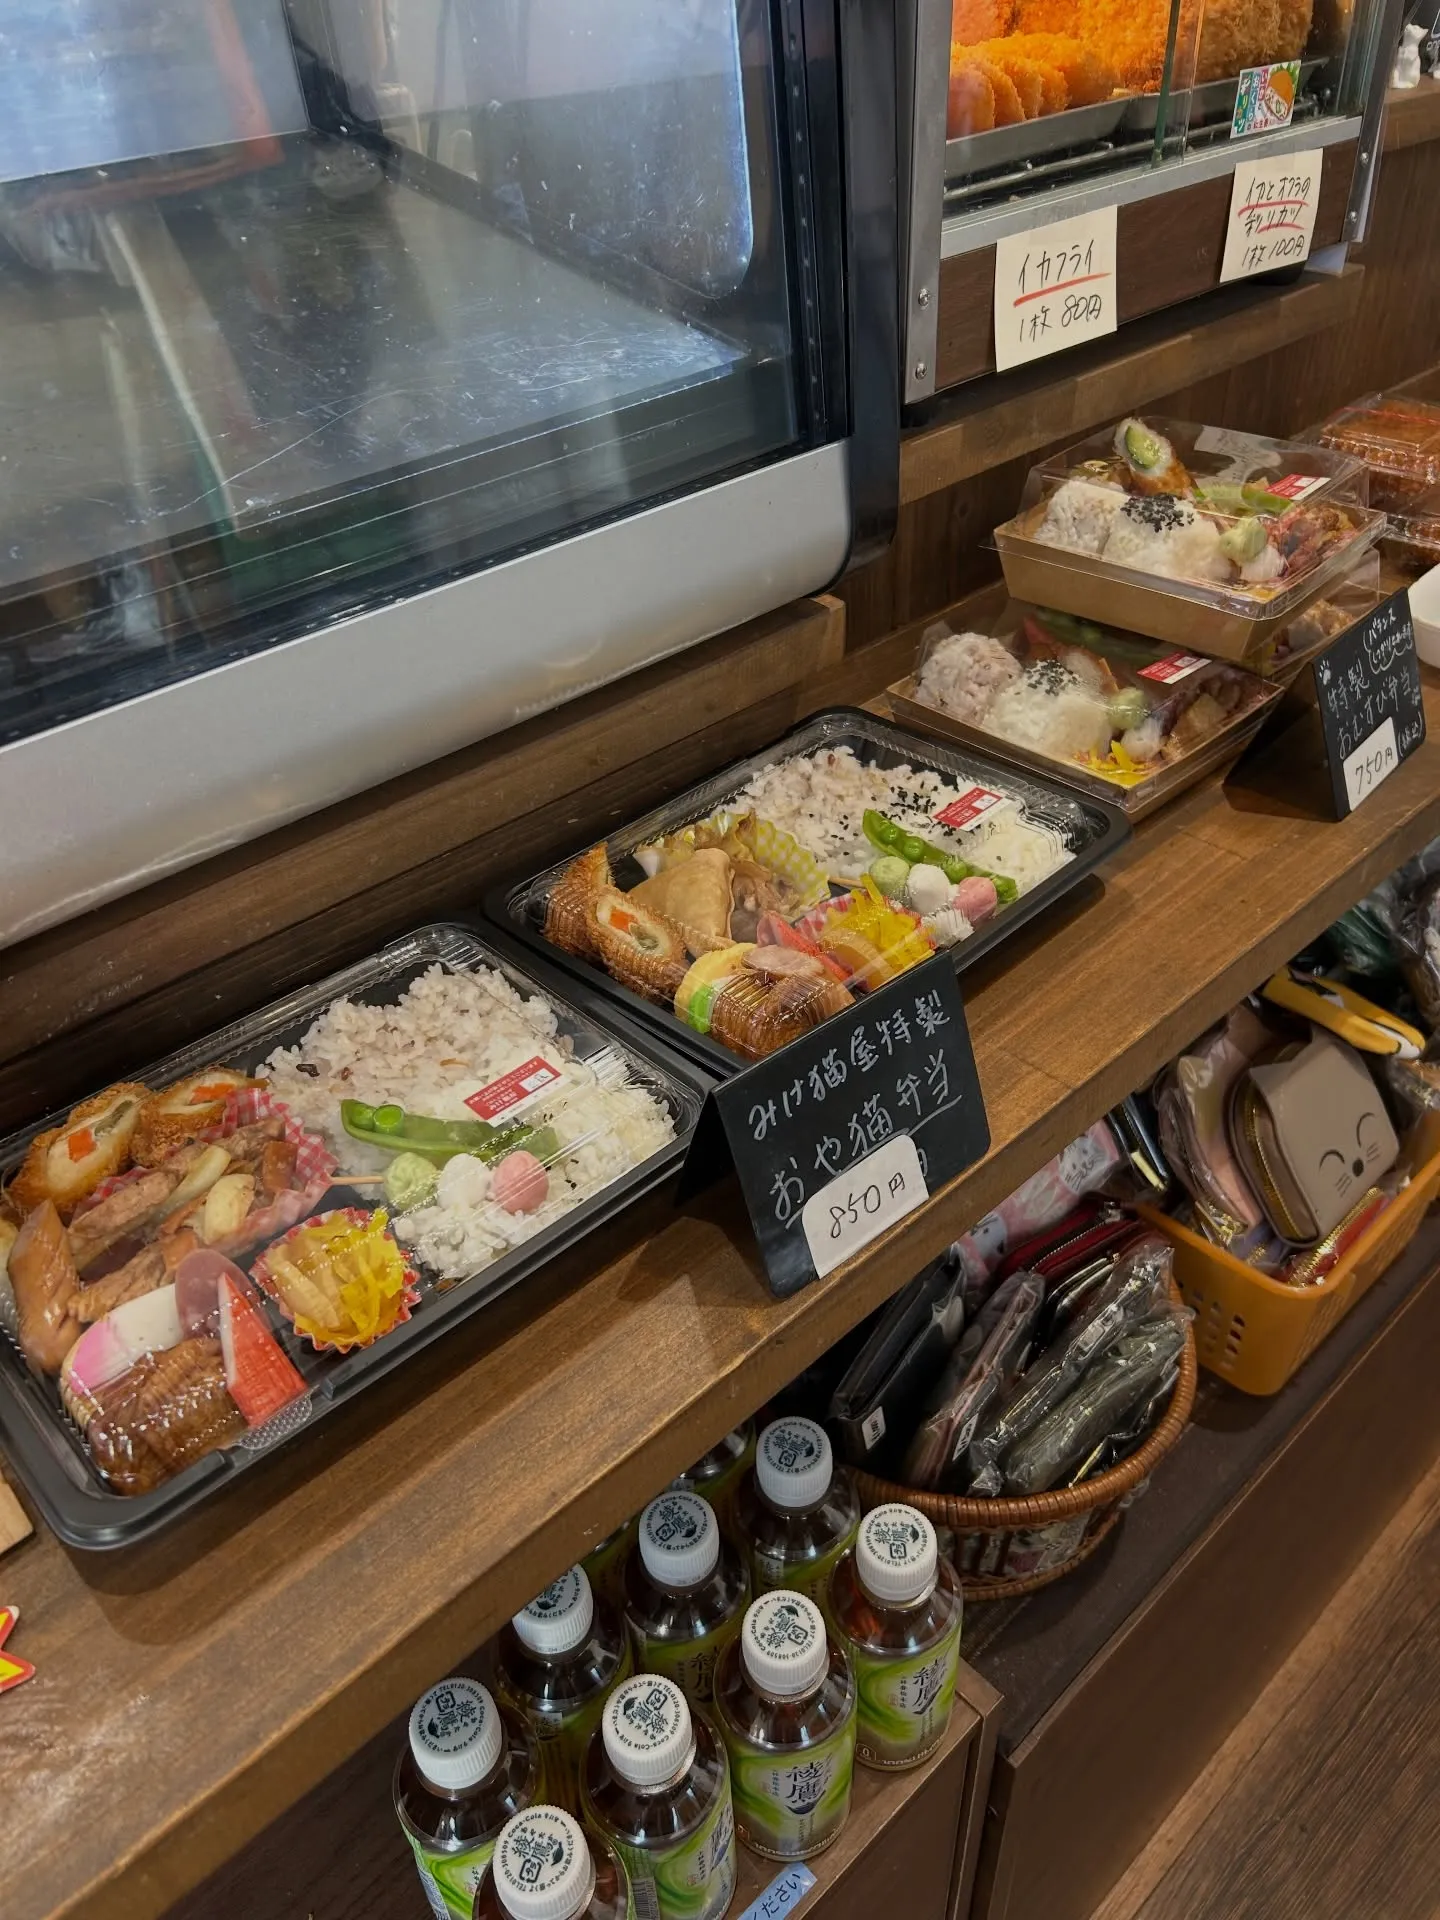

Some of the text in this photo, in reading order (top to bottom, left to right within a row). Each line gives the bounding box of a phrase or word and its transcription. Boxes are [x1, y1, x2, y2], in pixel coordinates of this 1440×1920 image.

[1245, 176, 1311, 207] イカとオクラの
[1018, 239, 1095, 294] イカフライ
[1061, 294, 1102, 328] 80円
[1327, 659, 1370, 719] 特製
[1337, 665, 1412, 760] おむすび弁当
[1354, 746, 1394, 794] 750円
[748, 989, 951, 1141] みけ猫屋特製
[769, 1048, 951, 1221] おや猫弁当
[828, 1172, 906, 1240] 850円
[750, 1619, 766, 1651] Coca-Cola
[468, 1705, 486, 1743] Coca-Cola
[631, 1700, 669, 1734] 綾鷹
[634, 1735, 669, 1750] Coca-Cola
[508, 1812, 542, 1838] Coca-Cola
[511, 1835, 554, 1865] 綾鷹
